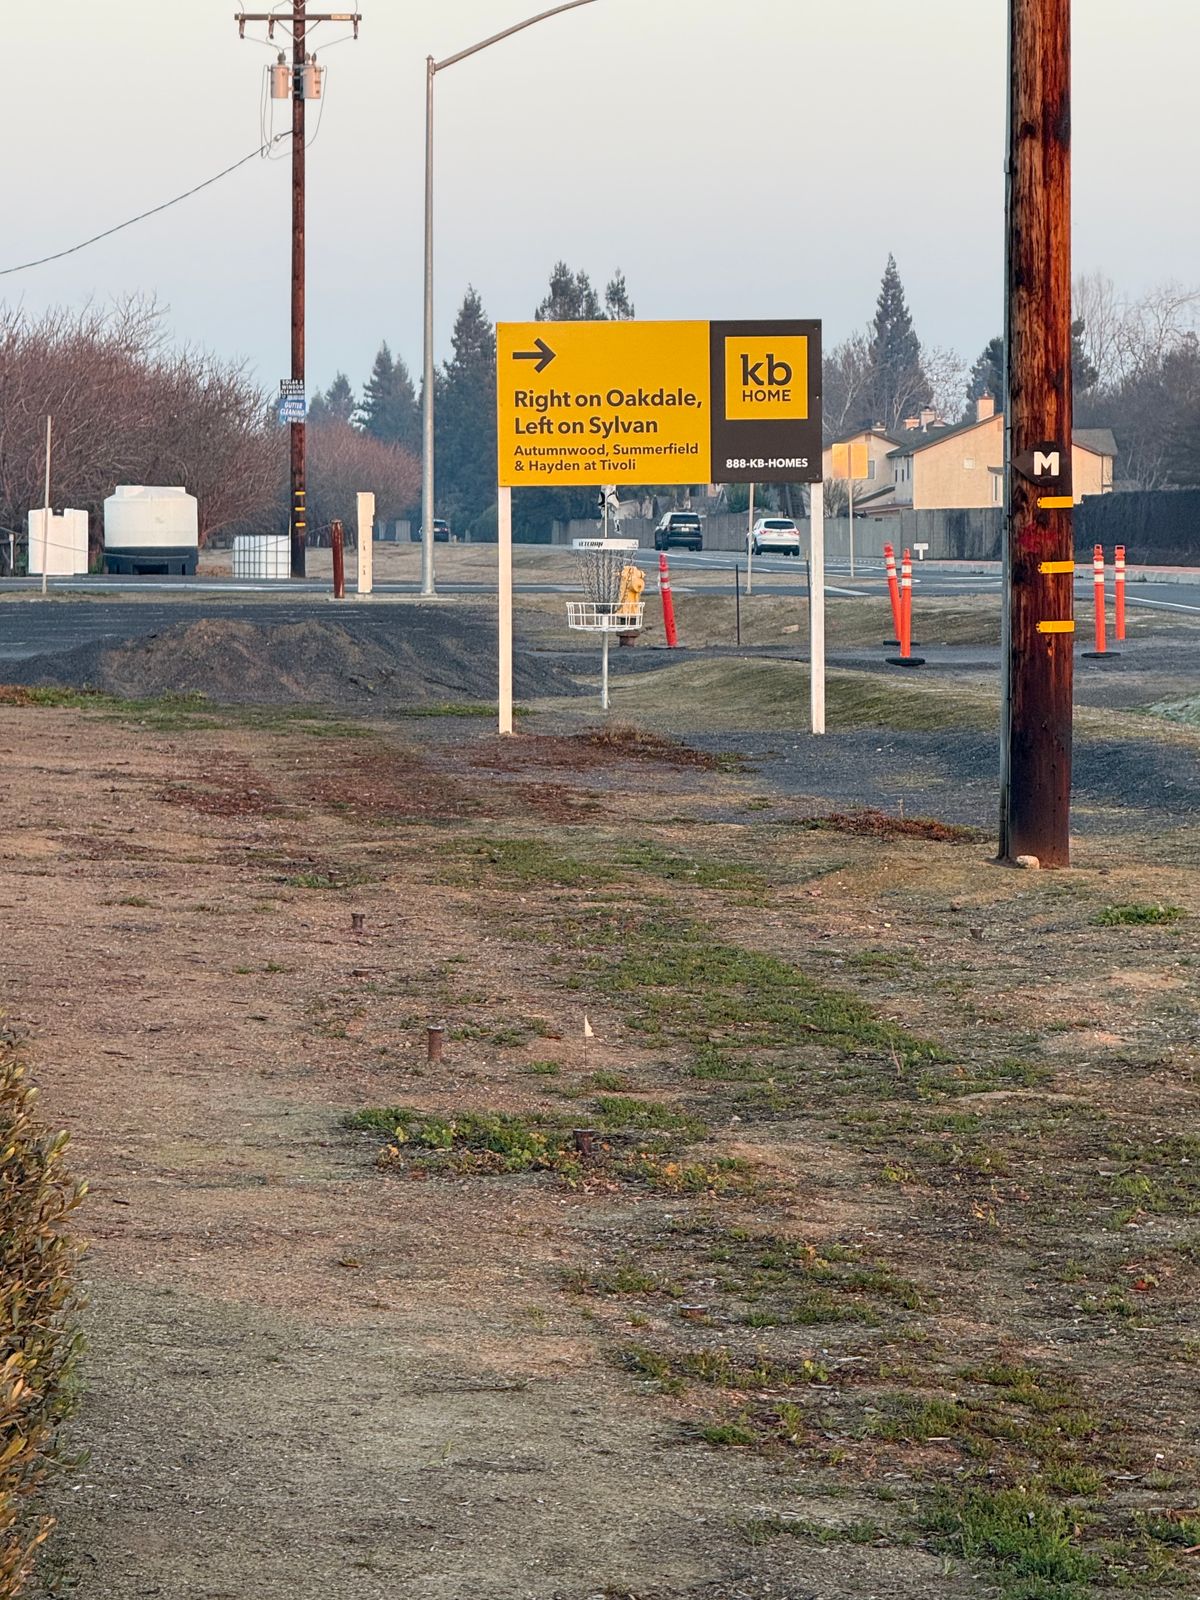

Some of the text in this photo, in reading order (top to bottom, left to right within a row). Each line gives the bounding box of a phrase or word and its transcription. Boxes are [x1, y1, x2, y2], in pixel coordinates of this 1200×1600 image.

[741, 353, 793, 387] kb
[514, 387, 703, 412] Right on Oakdale,
[742, 389, 792, 402] HOME
[280, 408, 305, 417] CLEANING
[515, 415, 658, 438] Left on Sylvan
[514, 442, 699, 457] Autumnwood, Summerfield
[514, 459, 636, 474] & Hayden at Tivoli
[725, 457, 809, 469] 888-KB-HOMES
[1033, 452, 1060, 476] M
